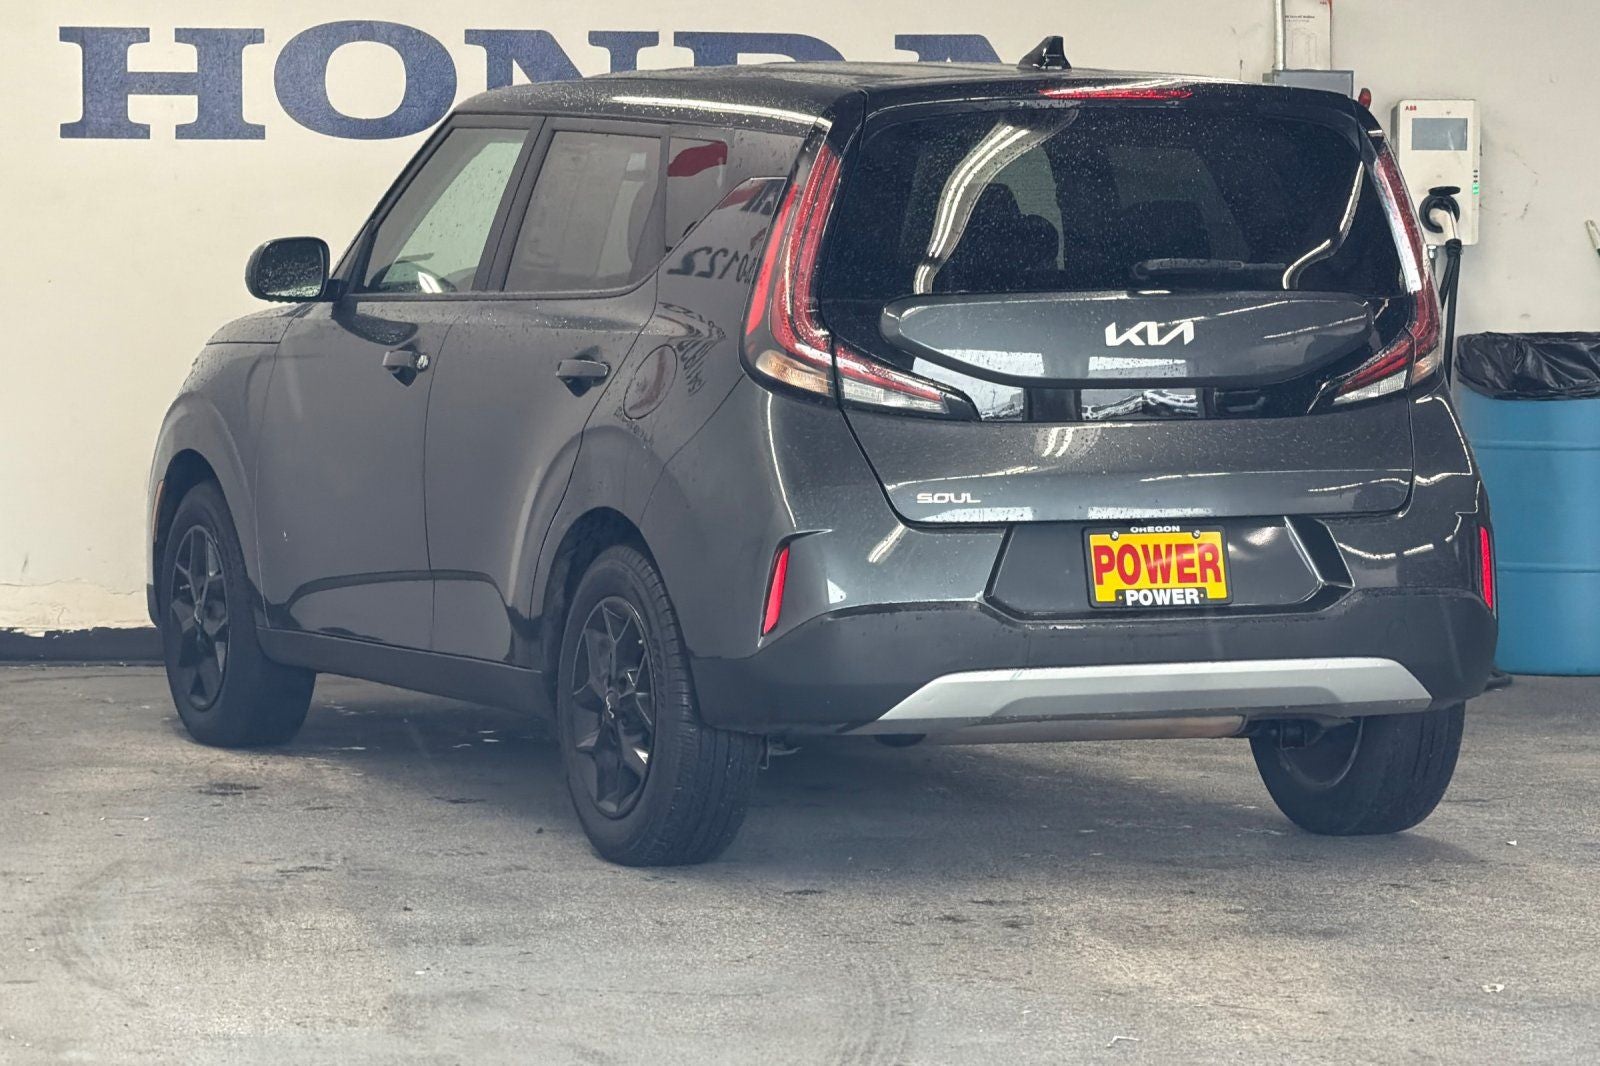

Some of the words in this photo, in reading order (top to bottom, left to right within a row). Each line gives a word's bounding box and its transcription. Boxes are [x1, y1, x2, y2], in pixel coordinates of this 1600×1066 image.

[1105, 321, 1194, 346] KIA
[917, 492, 981, 504] SOUL
[1130, 525, 1180, 533] OREGON
[1093, 543, 1222, 586] POWER
[1125, 588, 1200, 606] POWER
